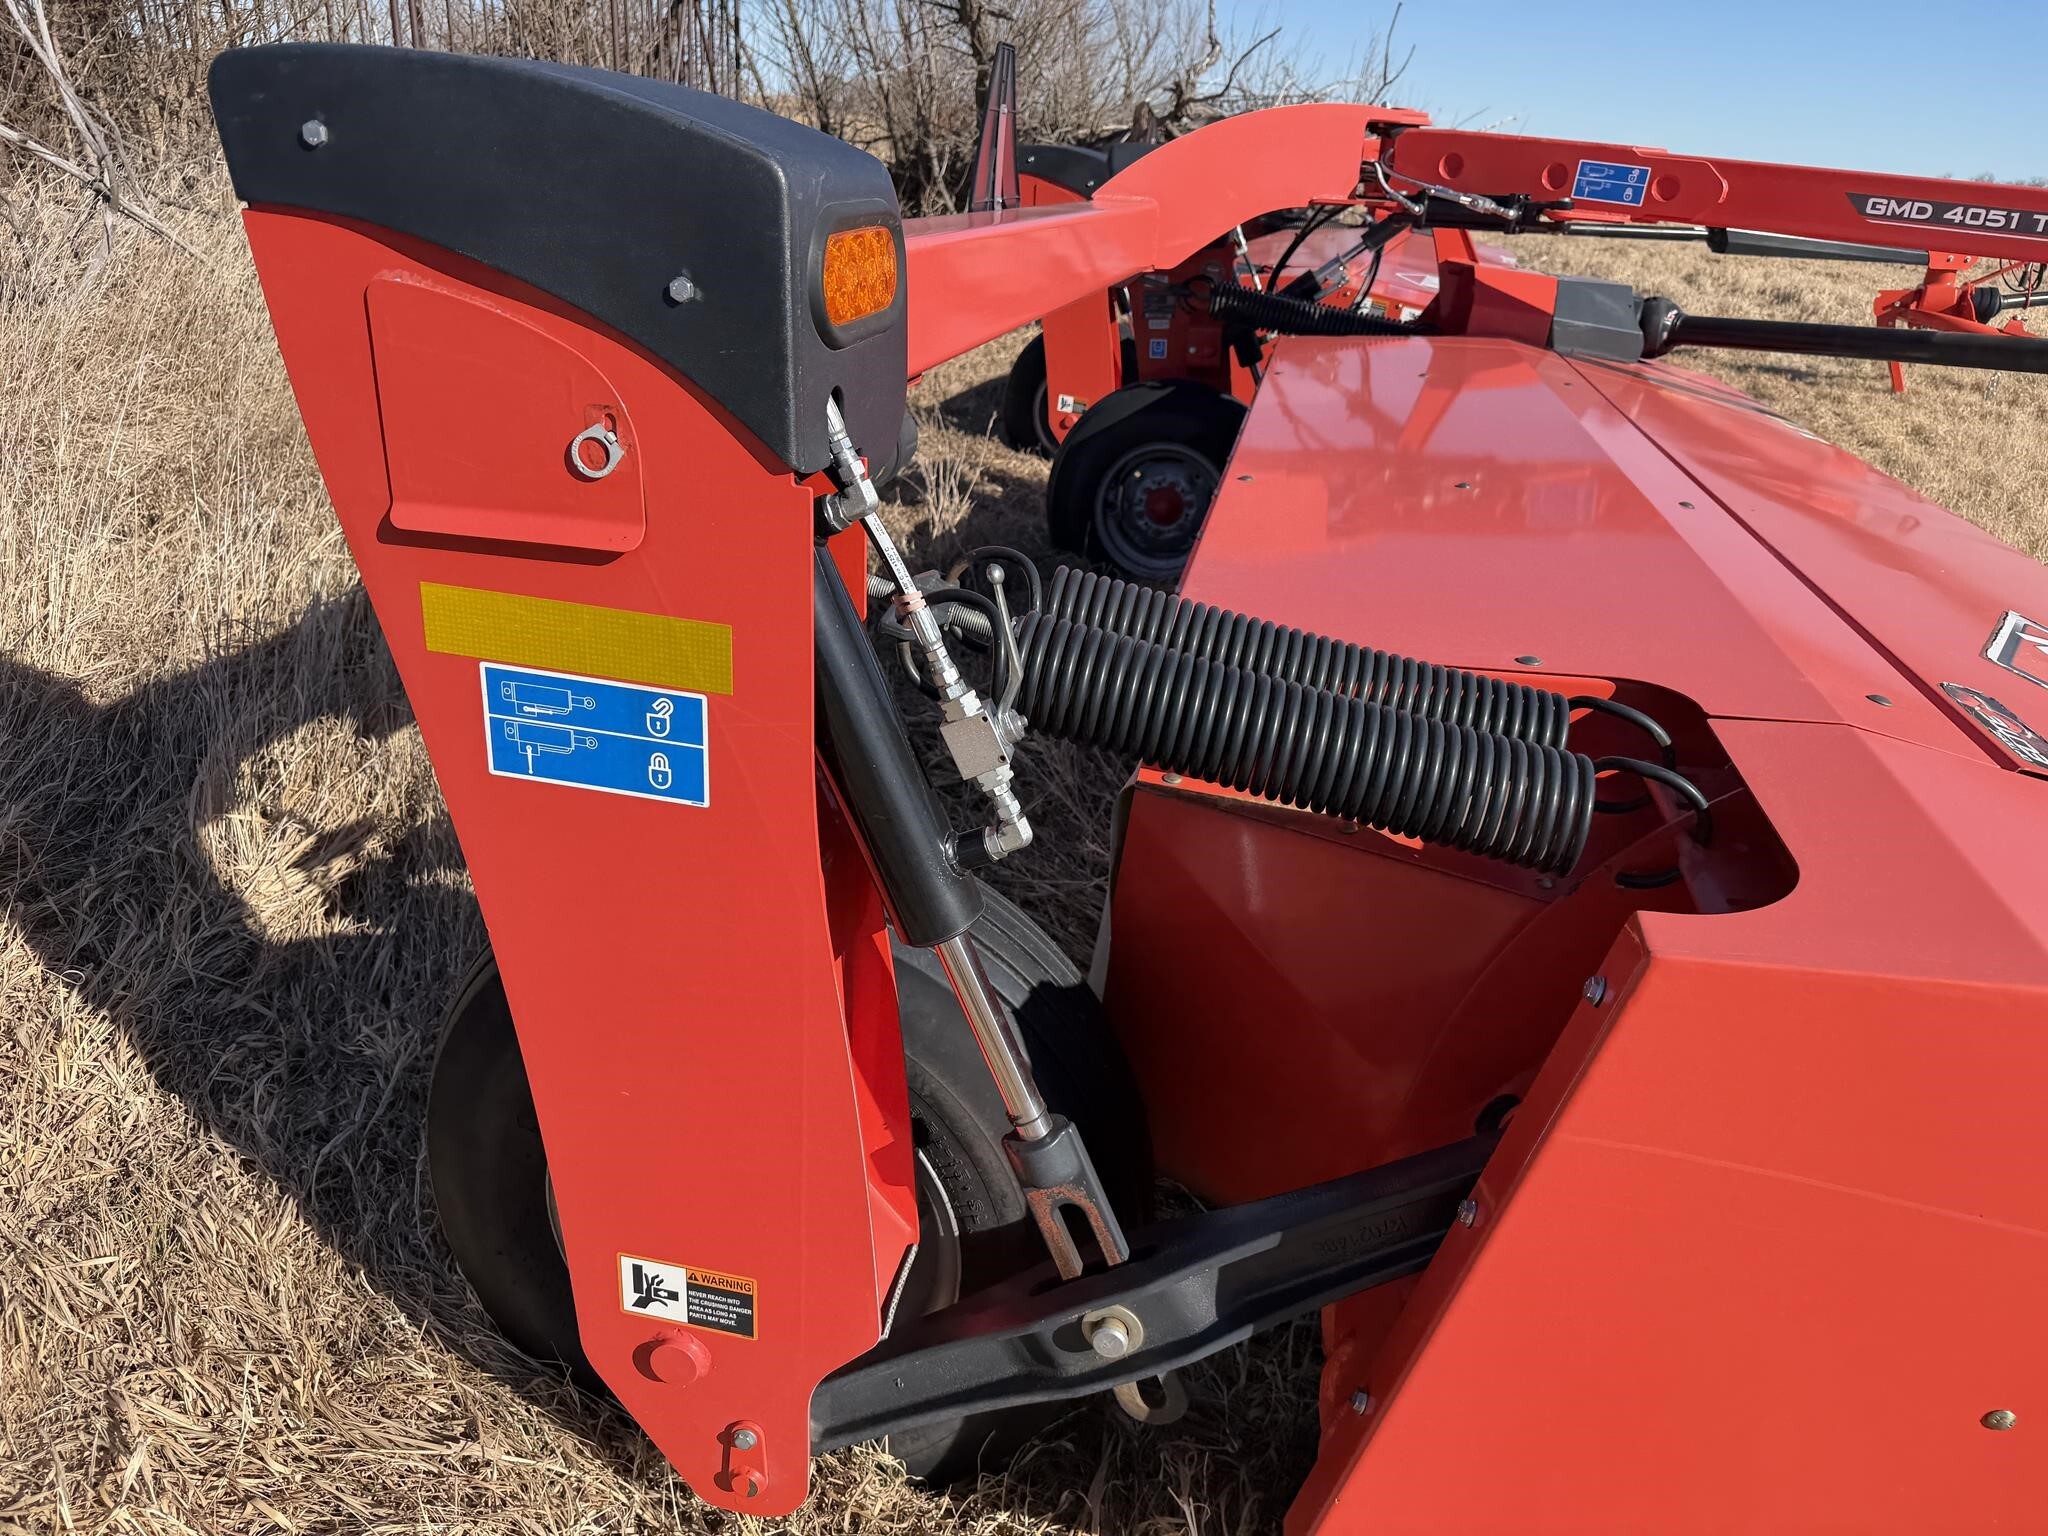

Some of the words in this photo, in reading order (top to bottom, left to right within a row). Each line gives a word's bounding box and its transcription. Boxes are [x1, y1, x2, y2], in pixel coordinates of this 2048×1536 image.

[1865, 197, 1934, 220] GMD
[1943, 206, 2021, 230] 4051
[701, 1273, 752, 1292] WARNING
[688, 1290, 707, 1298] NEVER
[707, 1294, 727, 1303] REACH
[689, 1304, 704, 1312] AREA
[713, 1309, 728, 1317] LONG
[700, 1300, 729, 1310] CRUSHING
[729, 1305, 752, 1315] DANGER
[689, 1311, 706, 1320] PARTS
[719, 1318, 737, 1326] MOVE.
